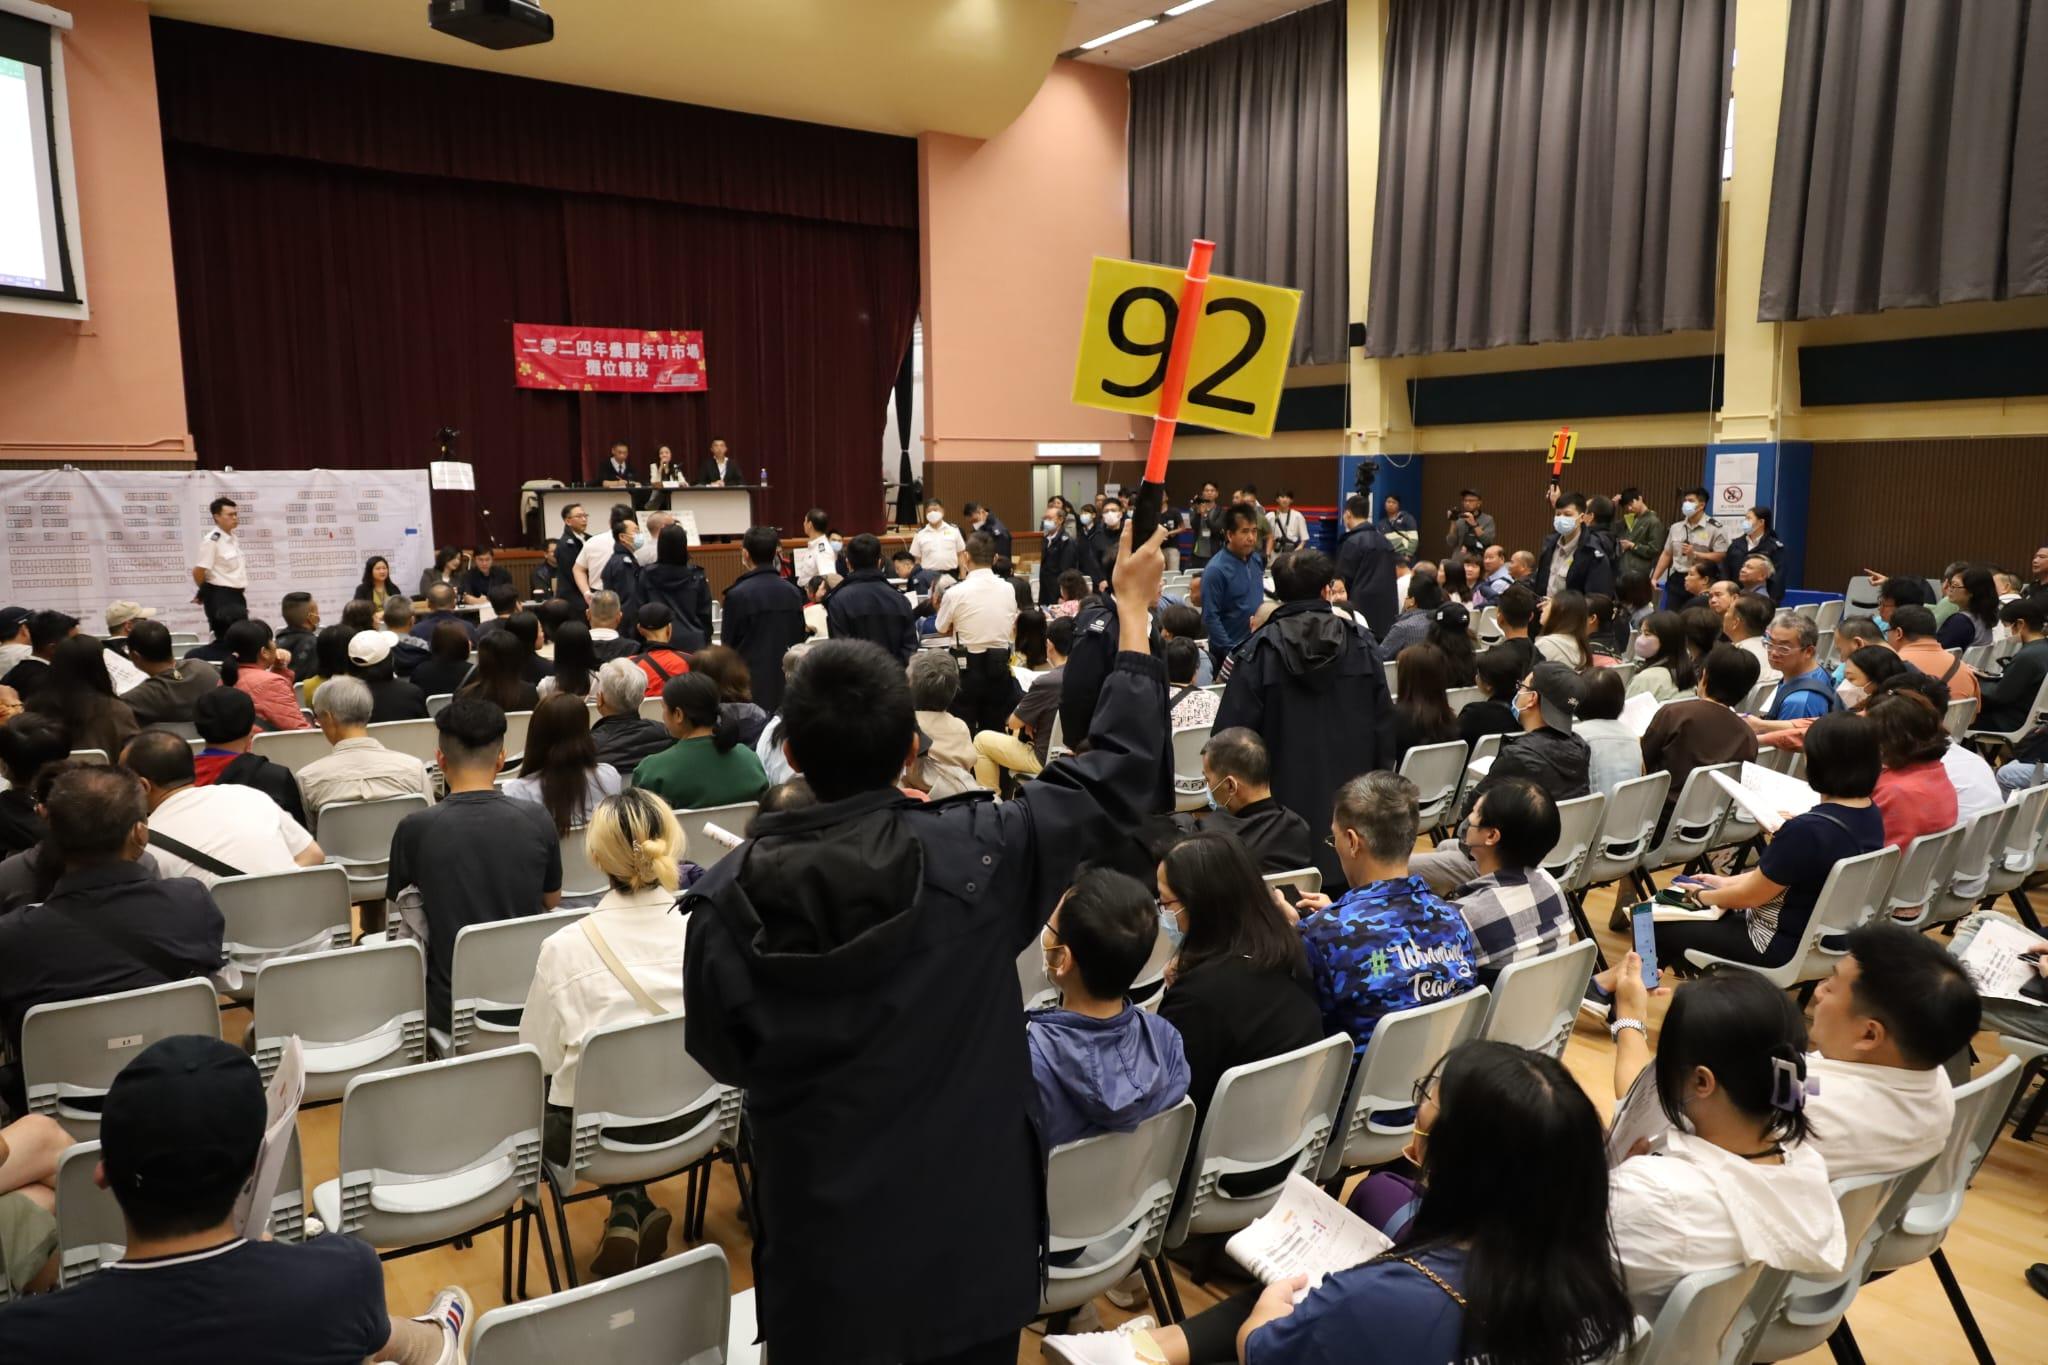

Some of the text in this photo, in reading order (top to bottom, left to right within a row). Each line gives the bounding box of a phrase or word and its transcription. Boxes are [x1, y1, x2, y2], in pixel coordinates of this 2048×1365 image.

[1101, 286, 1266, 415] 92
[1548, 434, 1571, 460] 51
[1407, 972, 1457, 1001] Team
